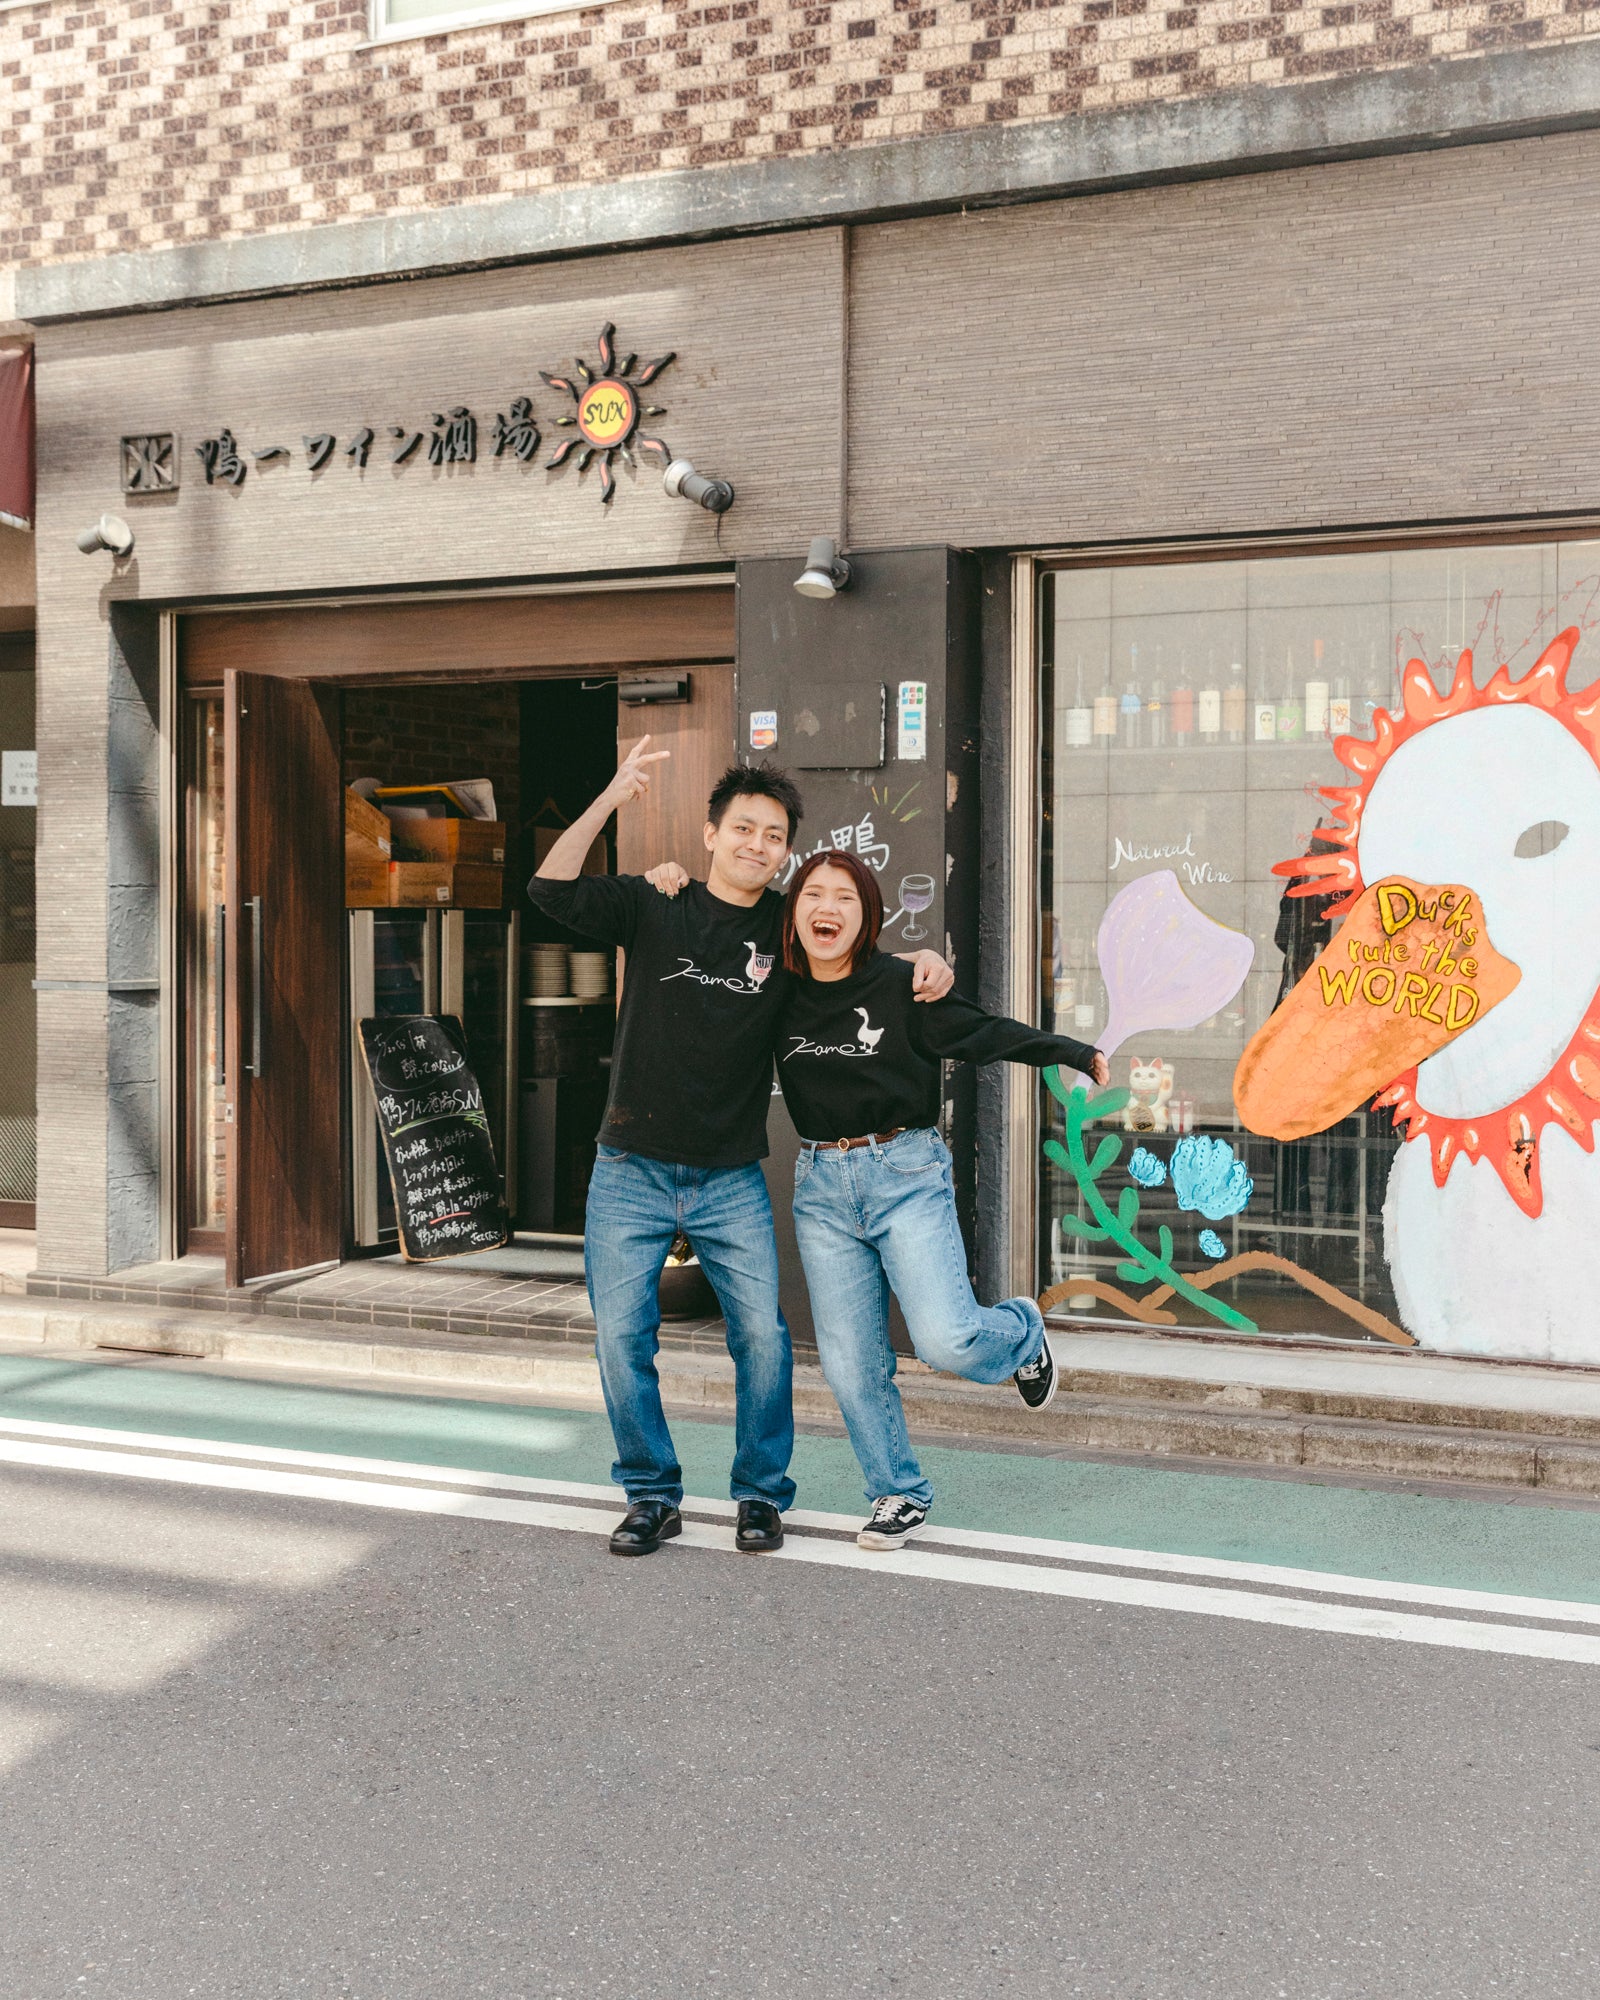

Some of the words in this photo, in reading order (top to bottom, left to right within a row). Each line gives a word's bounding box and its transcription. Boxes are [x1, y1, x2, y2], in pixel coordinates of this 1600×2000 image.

[753, 715, 776, 726] VISA
[1108, 832, 1196, 870] Natural
[1182, 861, 1234, 886] Wine
[1376, 883, 1479, 946] Ducks
[659, 957, 763, 993] Kamo
[1348, 939, 1411, 964] rule
[1421, 940, 1479, 979] the
[1318, 965, 1480, 1032] WORLD
[783, 1036, 878, 1062] Kamo
